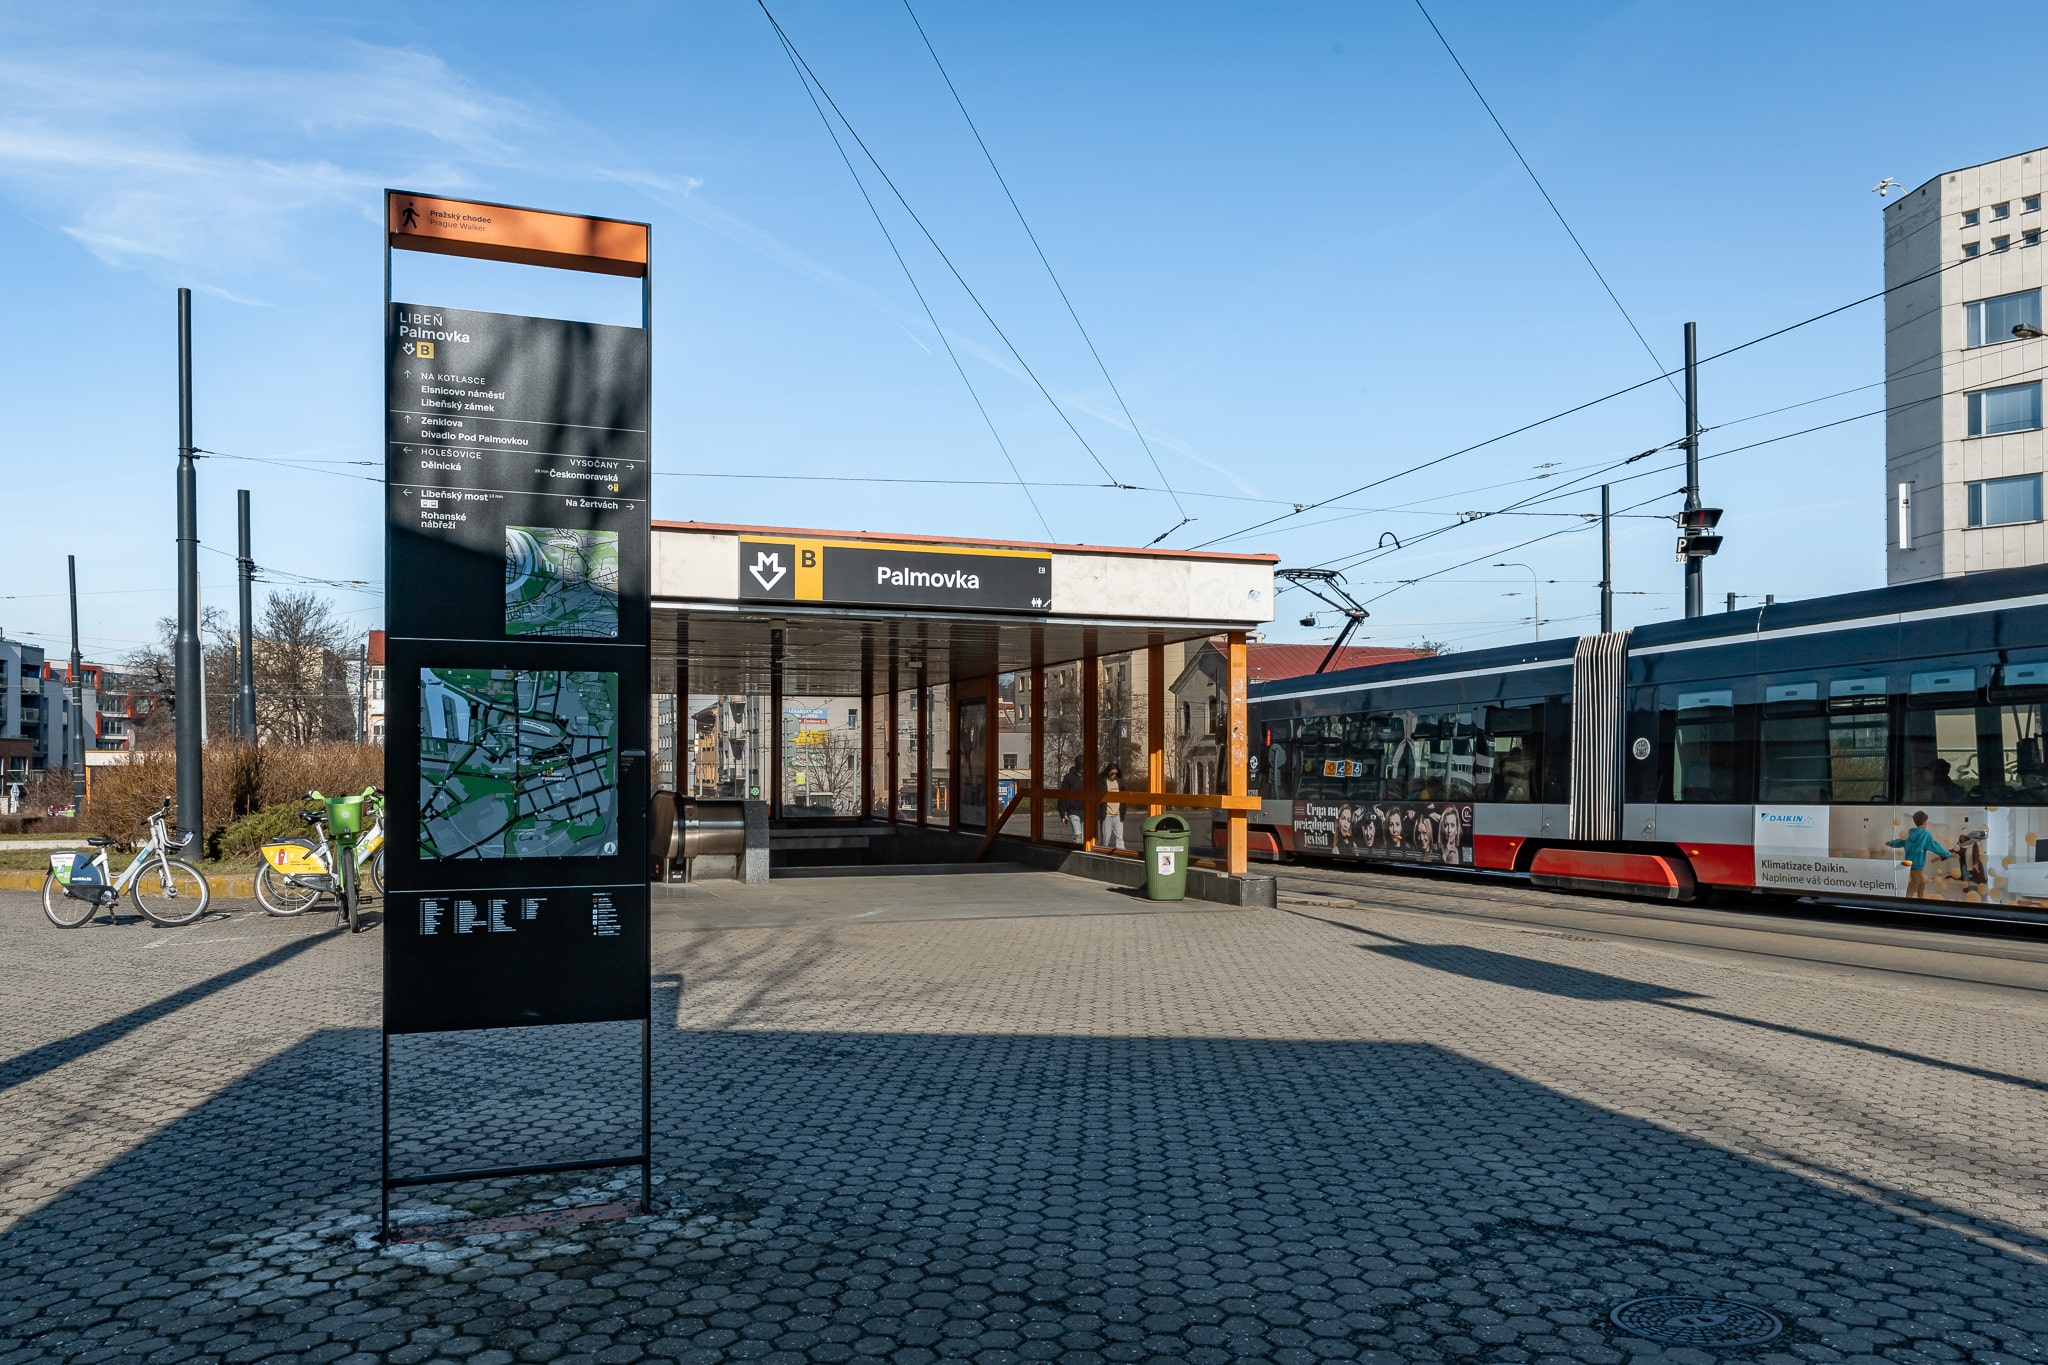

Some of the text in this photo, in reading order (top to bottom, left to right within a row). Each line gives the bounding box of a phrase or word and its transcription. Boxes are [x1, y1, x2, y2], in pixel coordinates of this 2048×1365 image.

[430, 210, 492, 224] Pražský chodec
[430, 219, 486, 232] Prague Walker
[400, 312, 443, 327] LIBEŇ
[400, 325, 470, 343] Palmovka
[420, 345, 430, 355] B
[421, 373, 486, 385] NA KOTLASCE
[421, 385, 505, 400] Elsnicovo náměstí
[421, 399, 495, 412] Libeňský zámek
[421, 416, 463, 428] Zenklova
[421, 430, 529, 446] Divadlo Pod Palmovkou
[421, 448, 482, 460] HOLEŠOVICE
[421, 460, 461, 471] Dělnická
[569, 458, 619, 469] VYSOČANY
[549, 468, 619, 482] Českomoravská
[421, 489, 462, 501] Libeňský
[464, 492, 489, 502] most
[565, 498, 619, 510] Na Žertvách
[421, 511, 467, 521] Rohanské
[1679, 514, 1687, 527] L
[421, 520, 456, 530] nábřeží
[1678, 539, 1687, 552] P
[801, 550, 816, 568] B
[877, 566, 980, 590] Palmovka
[1306, 803, 1327, 817] Urna
[1327, 805, 1339, 819] na
[1761, 860, 1848, 873] Klimatizace Daikin.
[1762, 872, 1805, 885] Naplníme
[1806, 875, 1821, 885] váš
[1823, 877, 1857, 888] domov
